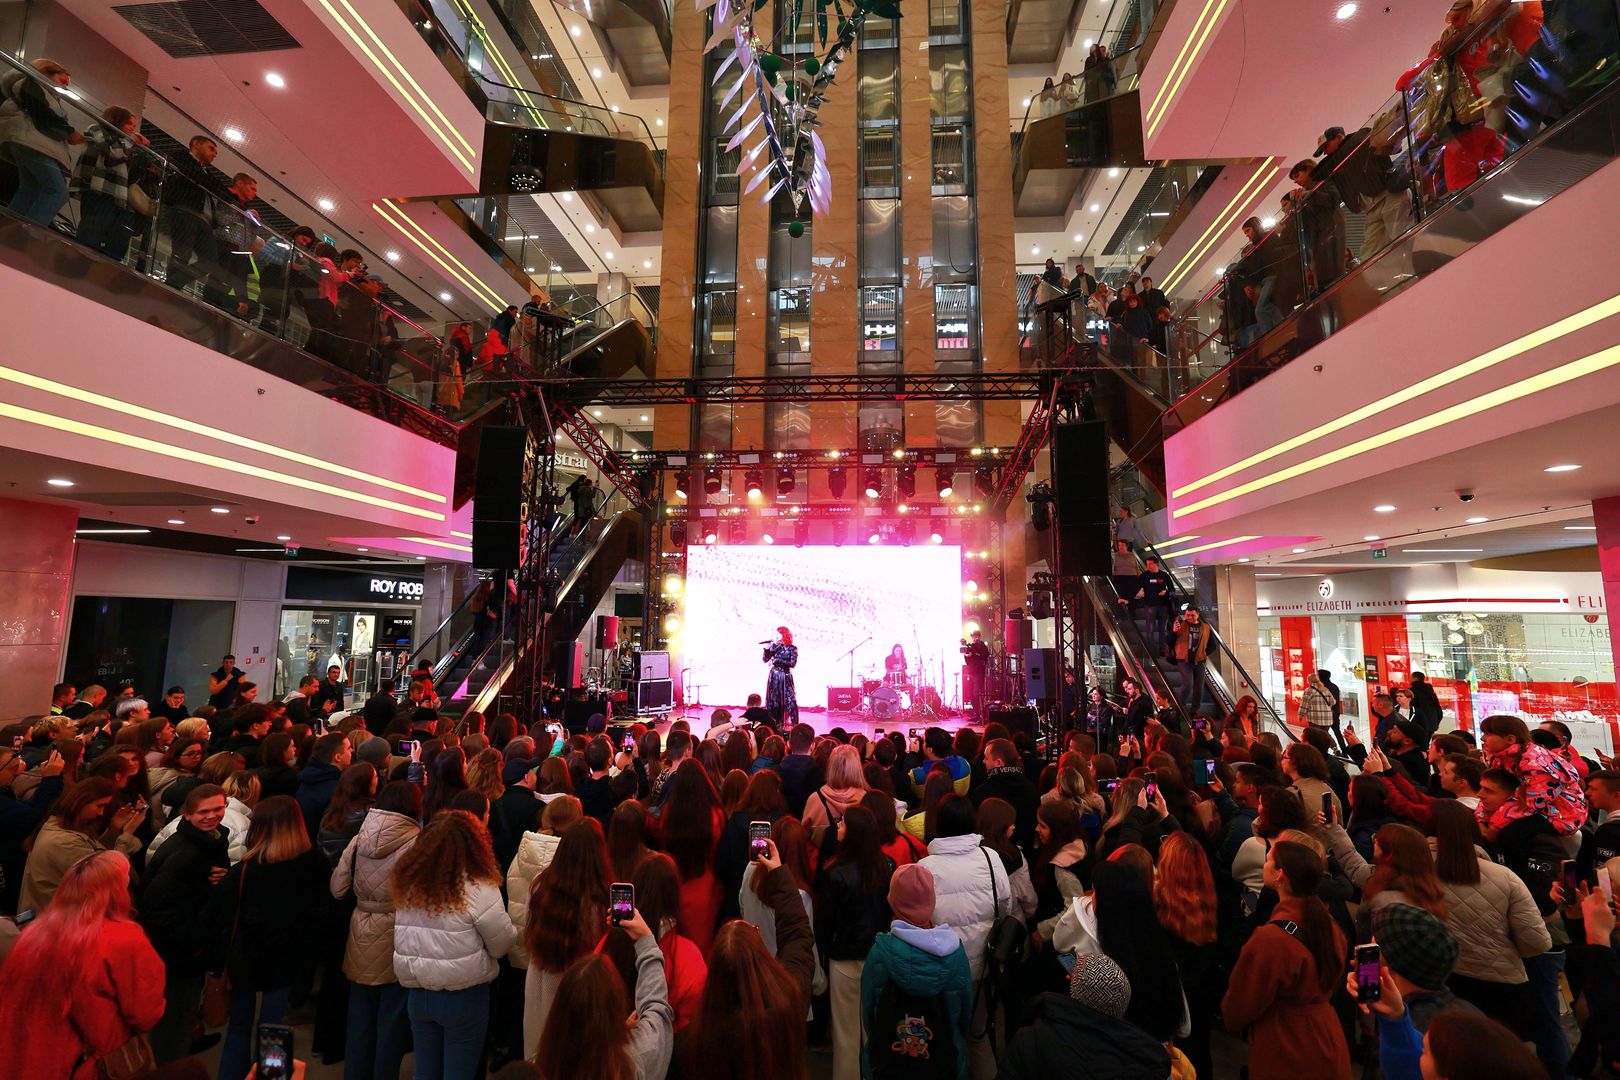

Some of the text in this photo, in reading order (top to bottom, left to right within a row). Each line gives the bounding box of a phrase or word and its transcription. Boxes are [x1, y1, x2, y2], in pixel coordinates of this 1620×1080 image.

[370, 578, 424, 595] ROY ROB
[1306, 600, 1352, 611] ELIZABETH
[1578, 595, 1603, 608] ELI
